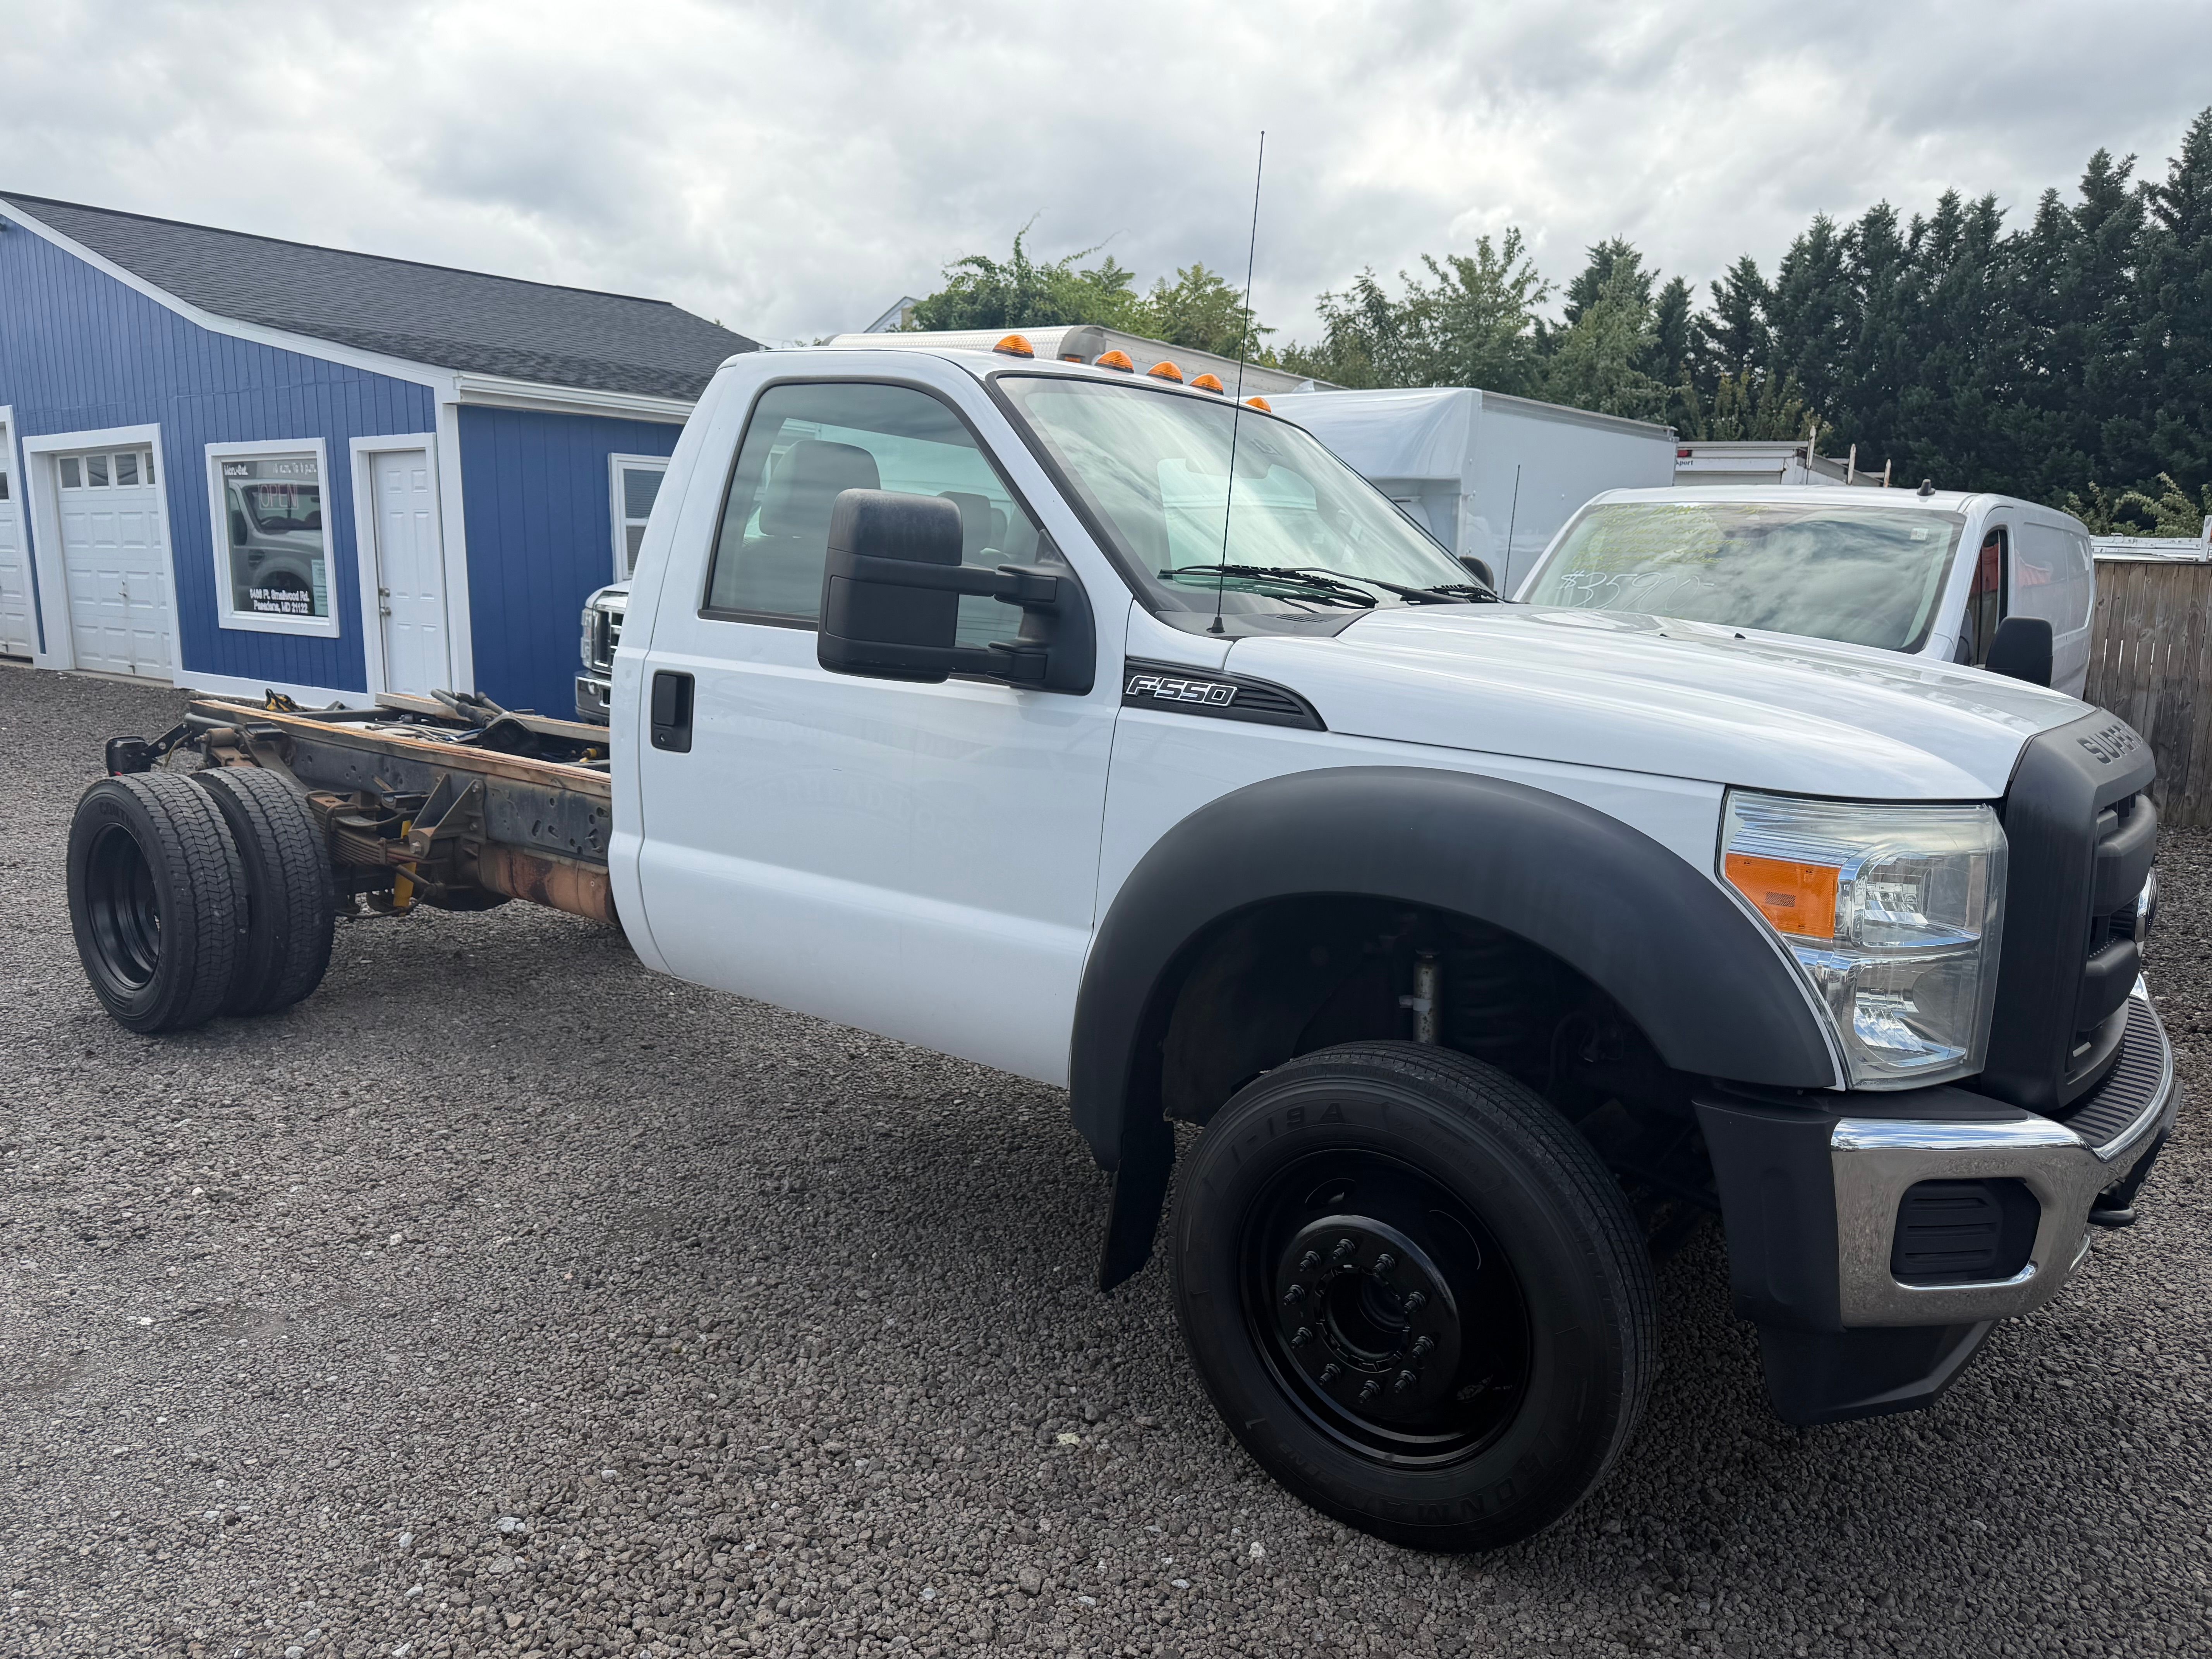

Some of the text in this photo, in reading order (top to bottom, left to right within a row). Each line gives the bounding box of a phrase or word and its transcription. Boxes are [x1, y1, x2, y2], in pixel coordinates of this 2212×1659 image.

[260, 484, 297, 507] OPEN
[1126, 675, 1238, 706] F-550
[1290, 718, 1302, 726] XL
